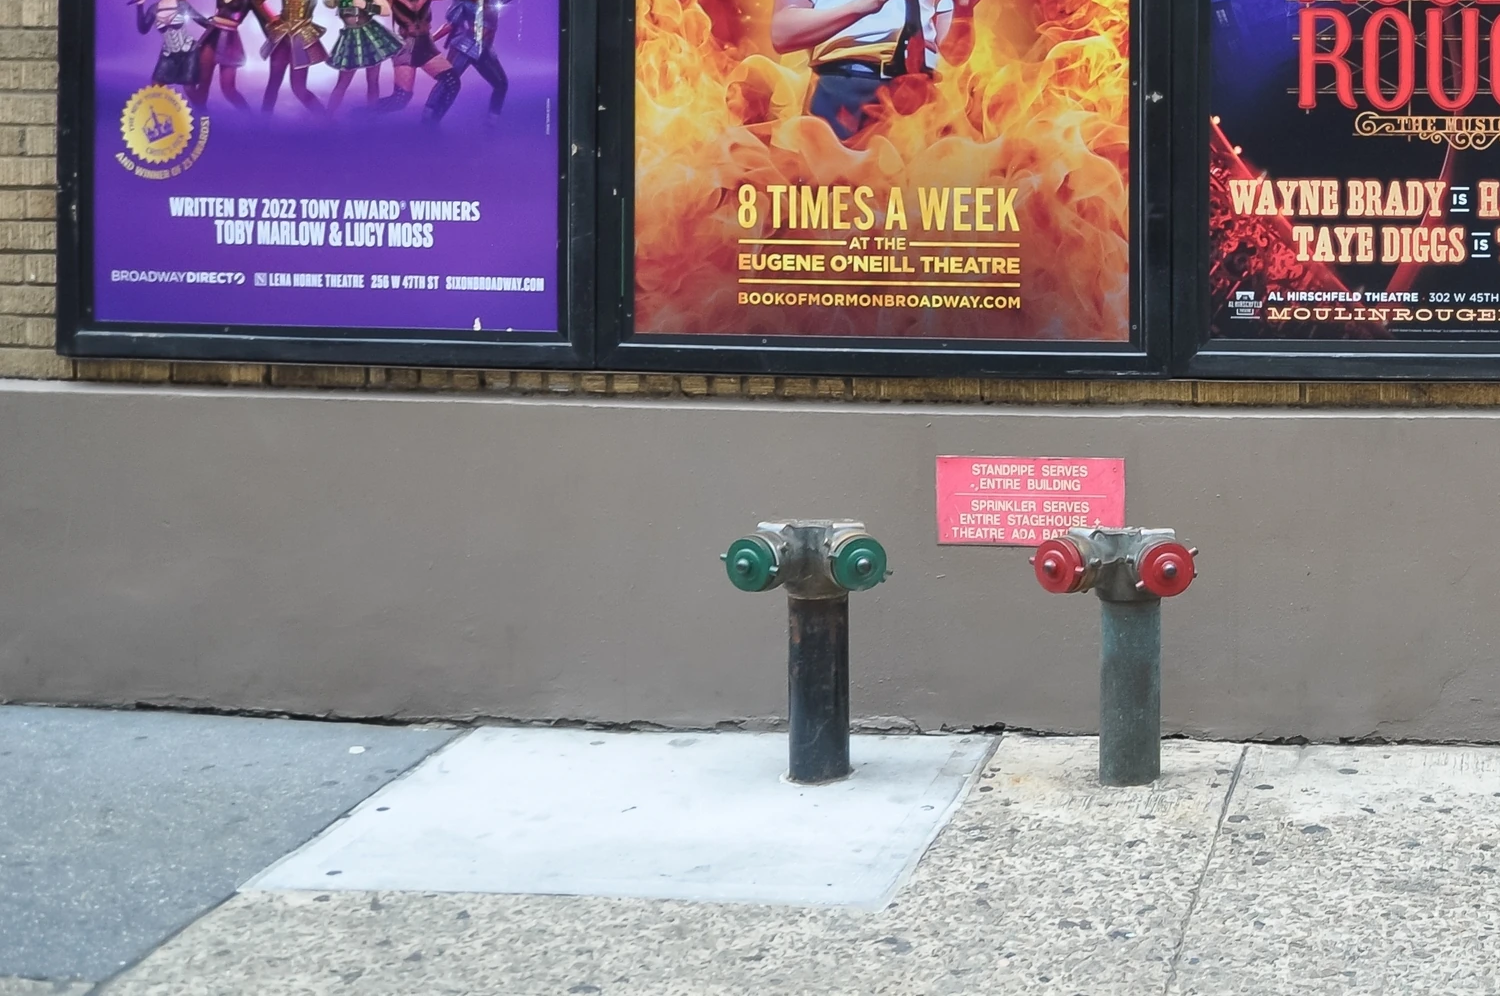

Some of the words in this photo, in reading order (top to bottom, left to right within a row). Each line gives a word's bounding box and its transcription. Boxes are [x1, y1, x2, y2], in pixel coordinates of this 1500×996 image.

[1397, 118, 1431, 132] THE
[115, 152, 135, 170] AND
[135, 166, 170, 179] WINNER
[1228, 179, 1339, 218] WAYNE
[1346, 179, 1447, 218] BRADY
[1452, 193, 1468, 205] IS
[169, 197, 234, 217] WRITTEN
[238, 198, 258, 218] BY
[262, 199, 296, 219] 2022
[300, 199, 340, 219] TONY
[410, 201, 480, 221] WINNERS
[738, 184, 757, 229] 8
[767, 184, 874, 230] TIMES
[885, 186, 908, 230] A
[918, 187, 1020, 231] WEEK
[214, 220, 254, 244] TOBY
[257, 221, 325, 246] MARLOW
[329, 222, 343, 246] &
[345, 222, 385, 247] LUCY
[388, 223, 434, 248] MOSS
[849, 238, 870, 250] AT
[874, 237, 906, 250] THE
[1292, 226, 1373, 263] TAYE
[1381, 227, 1465, 264] DIGGS
[1473, 238, 1489, 252] IS
[738, 254, 825, 272] EUGENE
[830, 255, 915, 272] O'NEILL
[920, 256, 1020, 274] THEATRE
[269, 273, 292, 287] LENA
[293, 274, 323, 288] HORNE
[325, 274, 364, 288] THEATRE
[391, 276, 401, 289] W
[403, 276, 425, 289] 47TH
[427, 276, 439, 289] ST
[446, 276, 544, 291] SIXONBROADWAY.COM
[738, 292, 1021, 309] BOOKOFMORMONBROADWAY.COM
[1268, 292, 1283, 301] AL
[1287, 292, 1361, 302] HIRSCHFELD
[1365, 292, 1418, 302] THEATRE
[1429, 292, 1450, 302] 302
[1454, 293, 1465, 302] W
[1469, 293, 1498, 302] 45TH
[972, 464, 1034, 477] STANDPIPE
[1042, 465, 1088, 477] SERVES
[979, 478, 1020, 490] ENTIRE
[1027, 479, 1081, 491] BUILDING
[971, 500, 1036, 512] SPRINKLER
[1043, 501, 1089, 512] SERVES
[960, 514, 1000, 525] ENTIRE
[1007, 514, 1087, 526] STAGEHOUSE
[952, 527, 1004, 539] THEATRE
